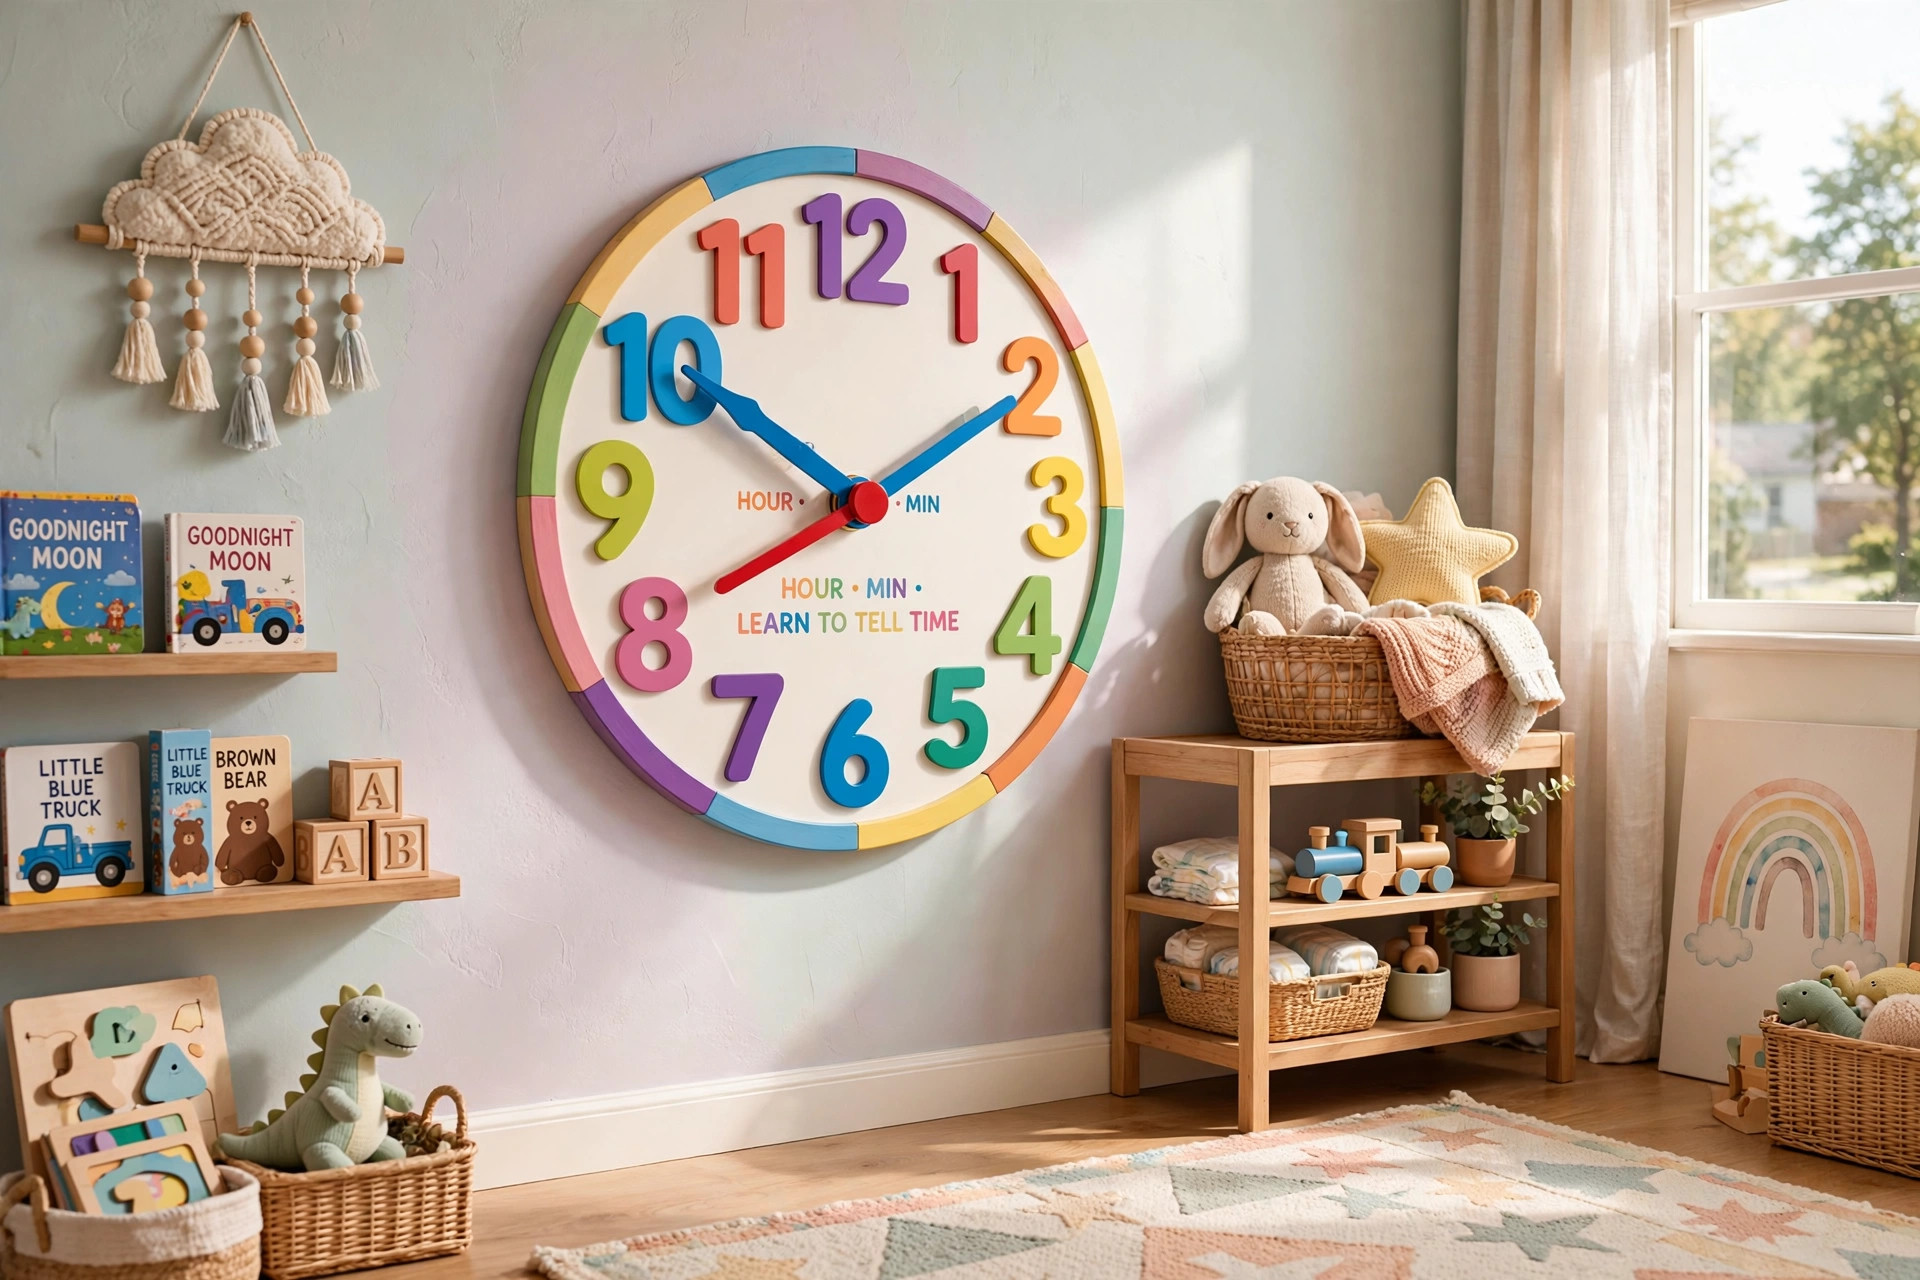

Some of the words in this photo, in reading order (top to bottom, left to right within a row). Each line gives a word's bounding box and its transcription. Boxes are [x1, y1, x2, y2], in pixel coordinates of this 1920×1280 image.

[802, 193, 909, 305] 12
[697, 218, 785, 329] 11
[940, 243, 978, 343] 1
[603, 312, 722, 426] 10
[1002, 336, 1062, 436] 2
[576, 440, 654, 560] 9
[1027, 456, 1086, 558] 3
[9, 518, 128, 542] GOODNIGHT
[187, 525, 294, 547] GOODNIGHT
[32, 546, 102, 570] MOON
[209, 550, 271, 571] MOON
[781, 577, 843, 599] HOUR
[866, 577, 906, 599] MIN
[615, 576, 692, 692] 8
[738, 612, 810, 634] LEARN
[817, 611, 847, 633] TO
[854, 611, 903, 633] TELL
[909, 610, 959, 632] TIME
[993, 575, 1062, 675] 4
[711, 673, 784, 782] 7
[925, 666, 988, 769] 5
[39, 757, 104, 777] LITTLE
[167, 747, 208, 762] LITTLE
[171, 764, 202, 779] BLUE
[215, 748, 276, 769] BROWN
[820, 697, 890, 808] 6
[48, 778, 94, 798] BLUE
[166, 781, 208, 796] TRUCK
[224, 770, 267, 790] BEAR
[357, 772, 394, 811] A
[40, 799, 102, 819] TRUCK
[320, 834, 358, 874] A
[384, 830, 419, 869] B
